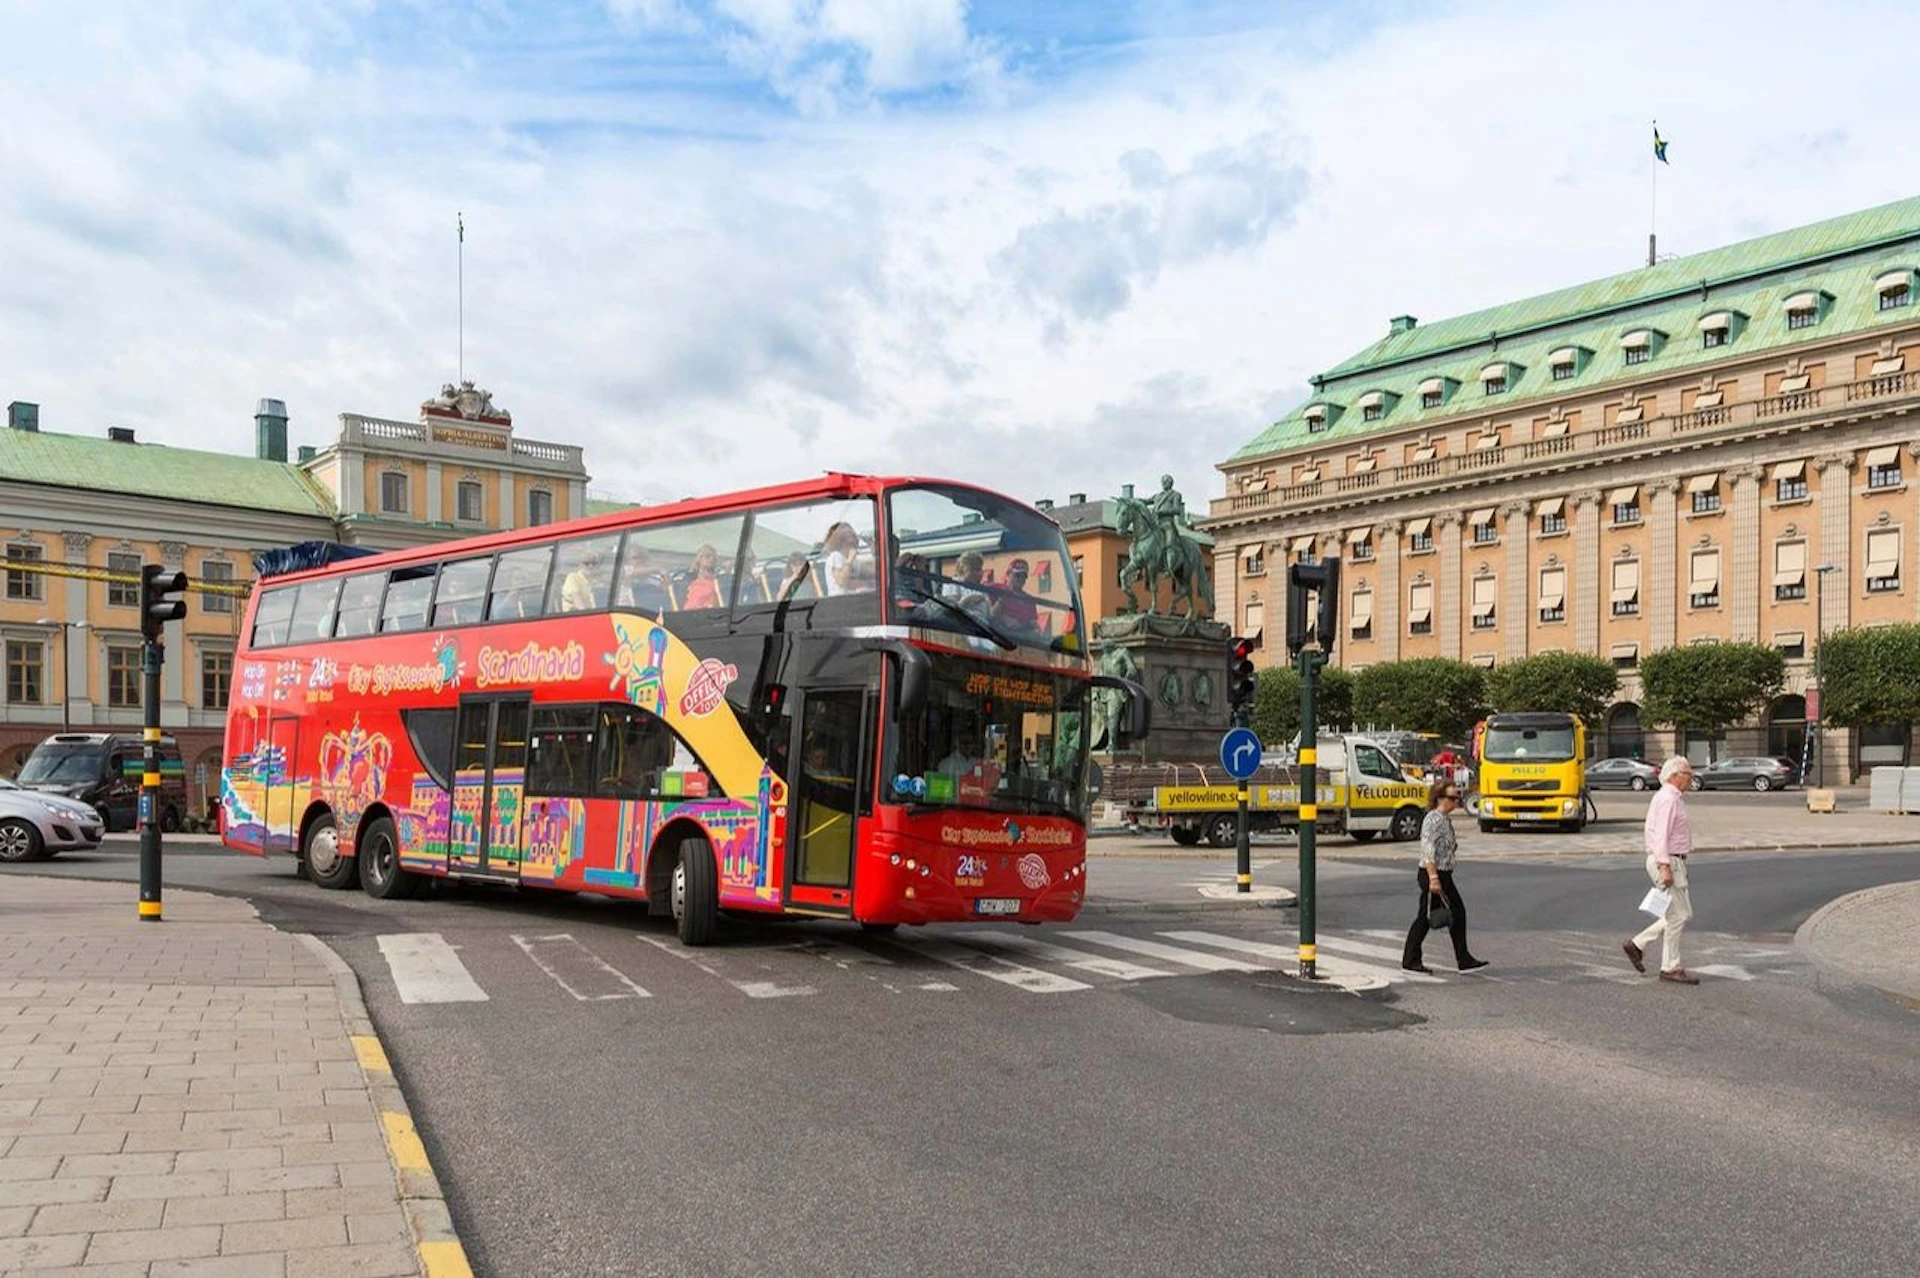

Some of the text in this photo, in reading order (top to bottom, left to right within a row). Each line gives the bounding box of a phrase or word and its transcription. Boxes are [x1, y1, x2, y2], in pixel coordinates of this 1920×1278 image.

[684, 666, 736, 711] OFFICIAL
[966, 682, 990, 696] CITY
[1356, 786, 1425, 799] YELLOWLINE
[956, 855, 974, 876] 24
